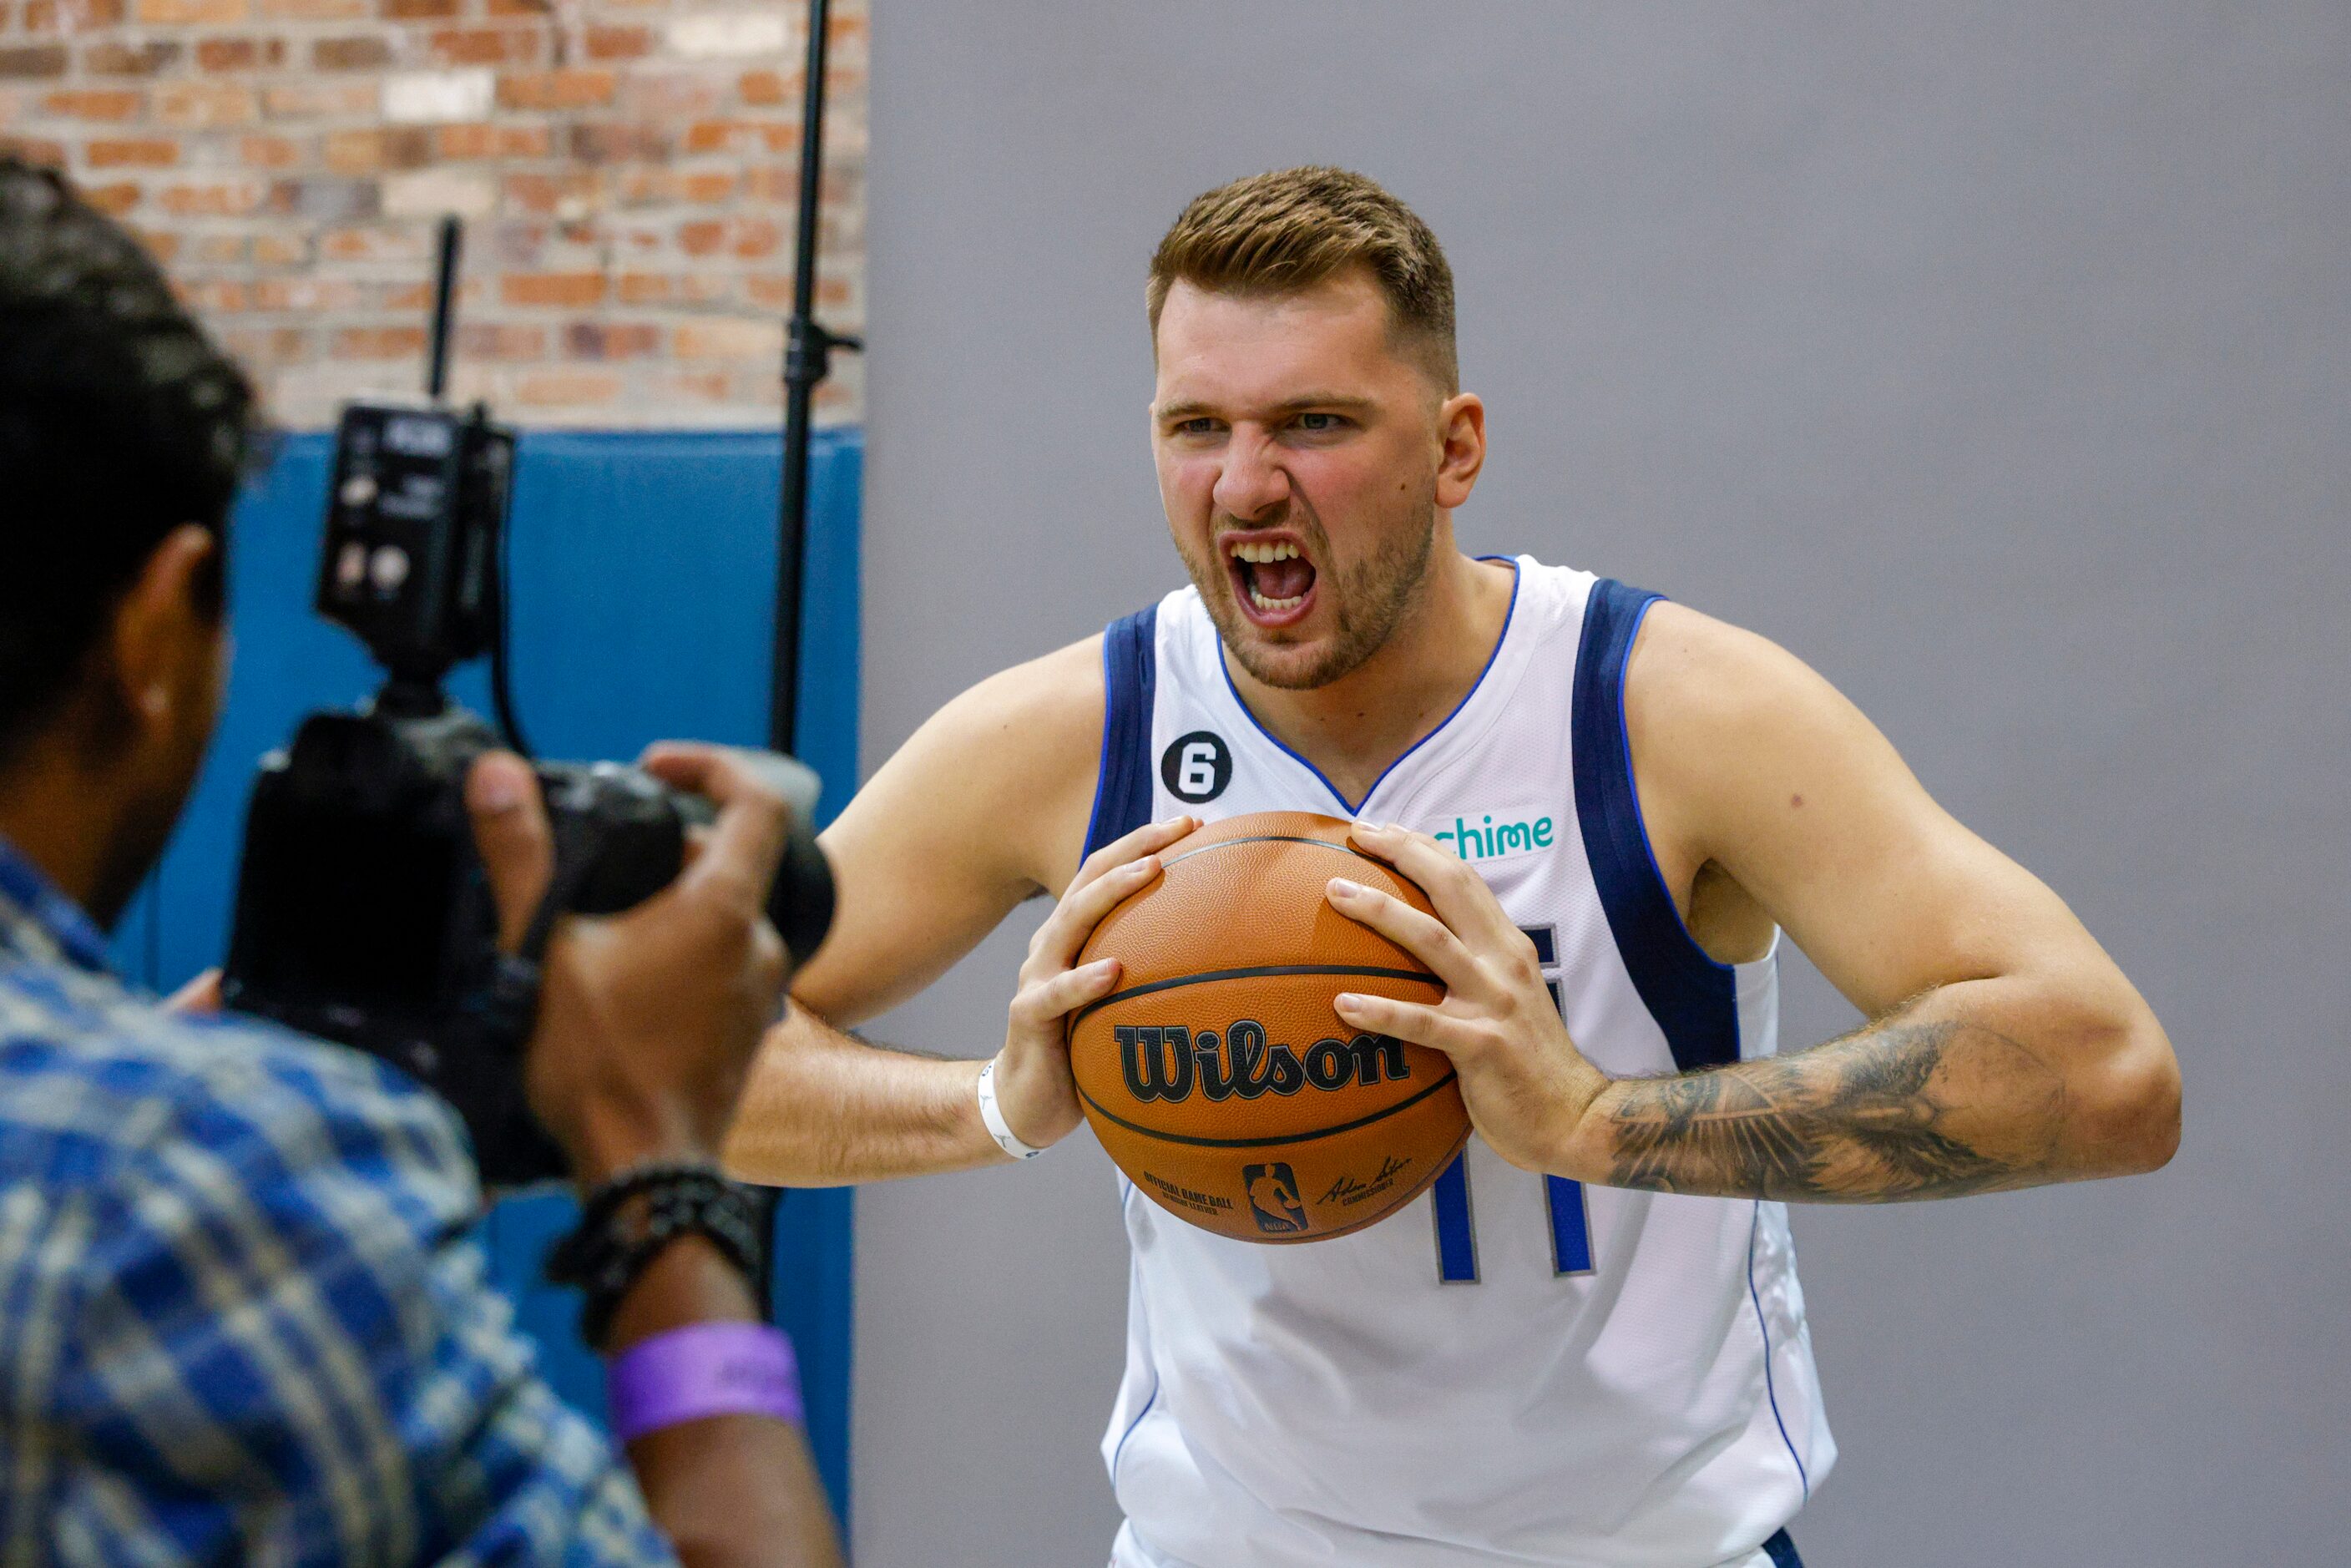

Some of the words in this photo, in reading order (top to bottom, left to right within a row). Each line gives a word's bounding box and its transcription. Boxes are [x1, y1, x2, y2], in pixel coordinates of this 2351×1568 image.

[1178, 742, 1216, 795] 6
[1115, 1019, 1411, 1104] Wilson
[1143, 1171, 1181, 1198] OFFICIAL
[1181, 1188, 1208, 1206] GAME
[1208, 1195, 1234, 1210] BALL
